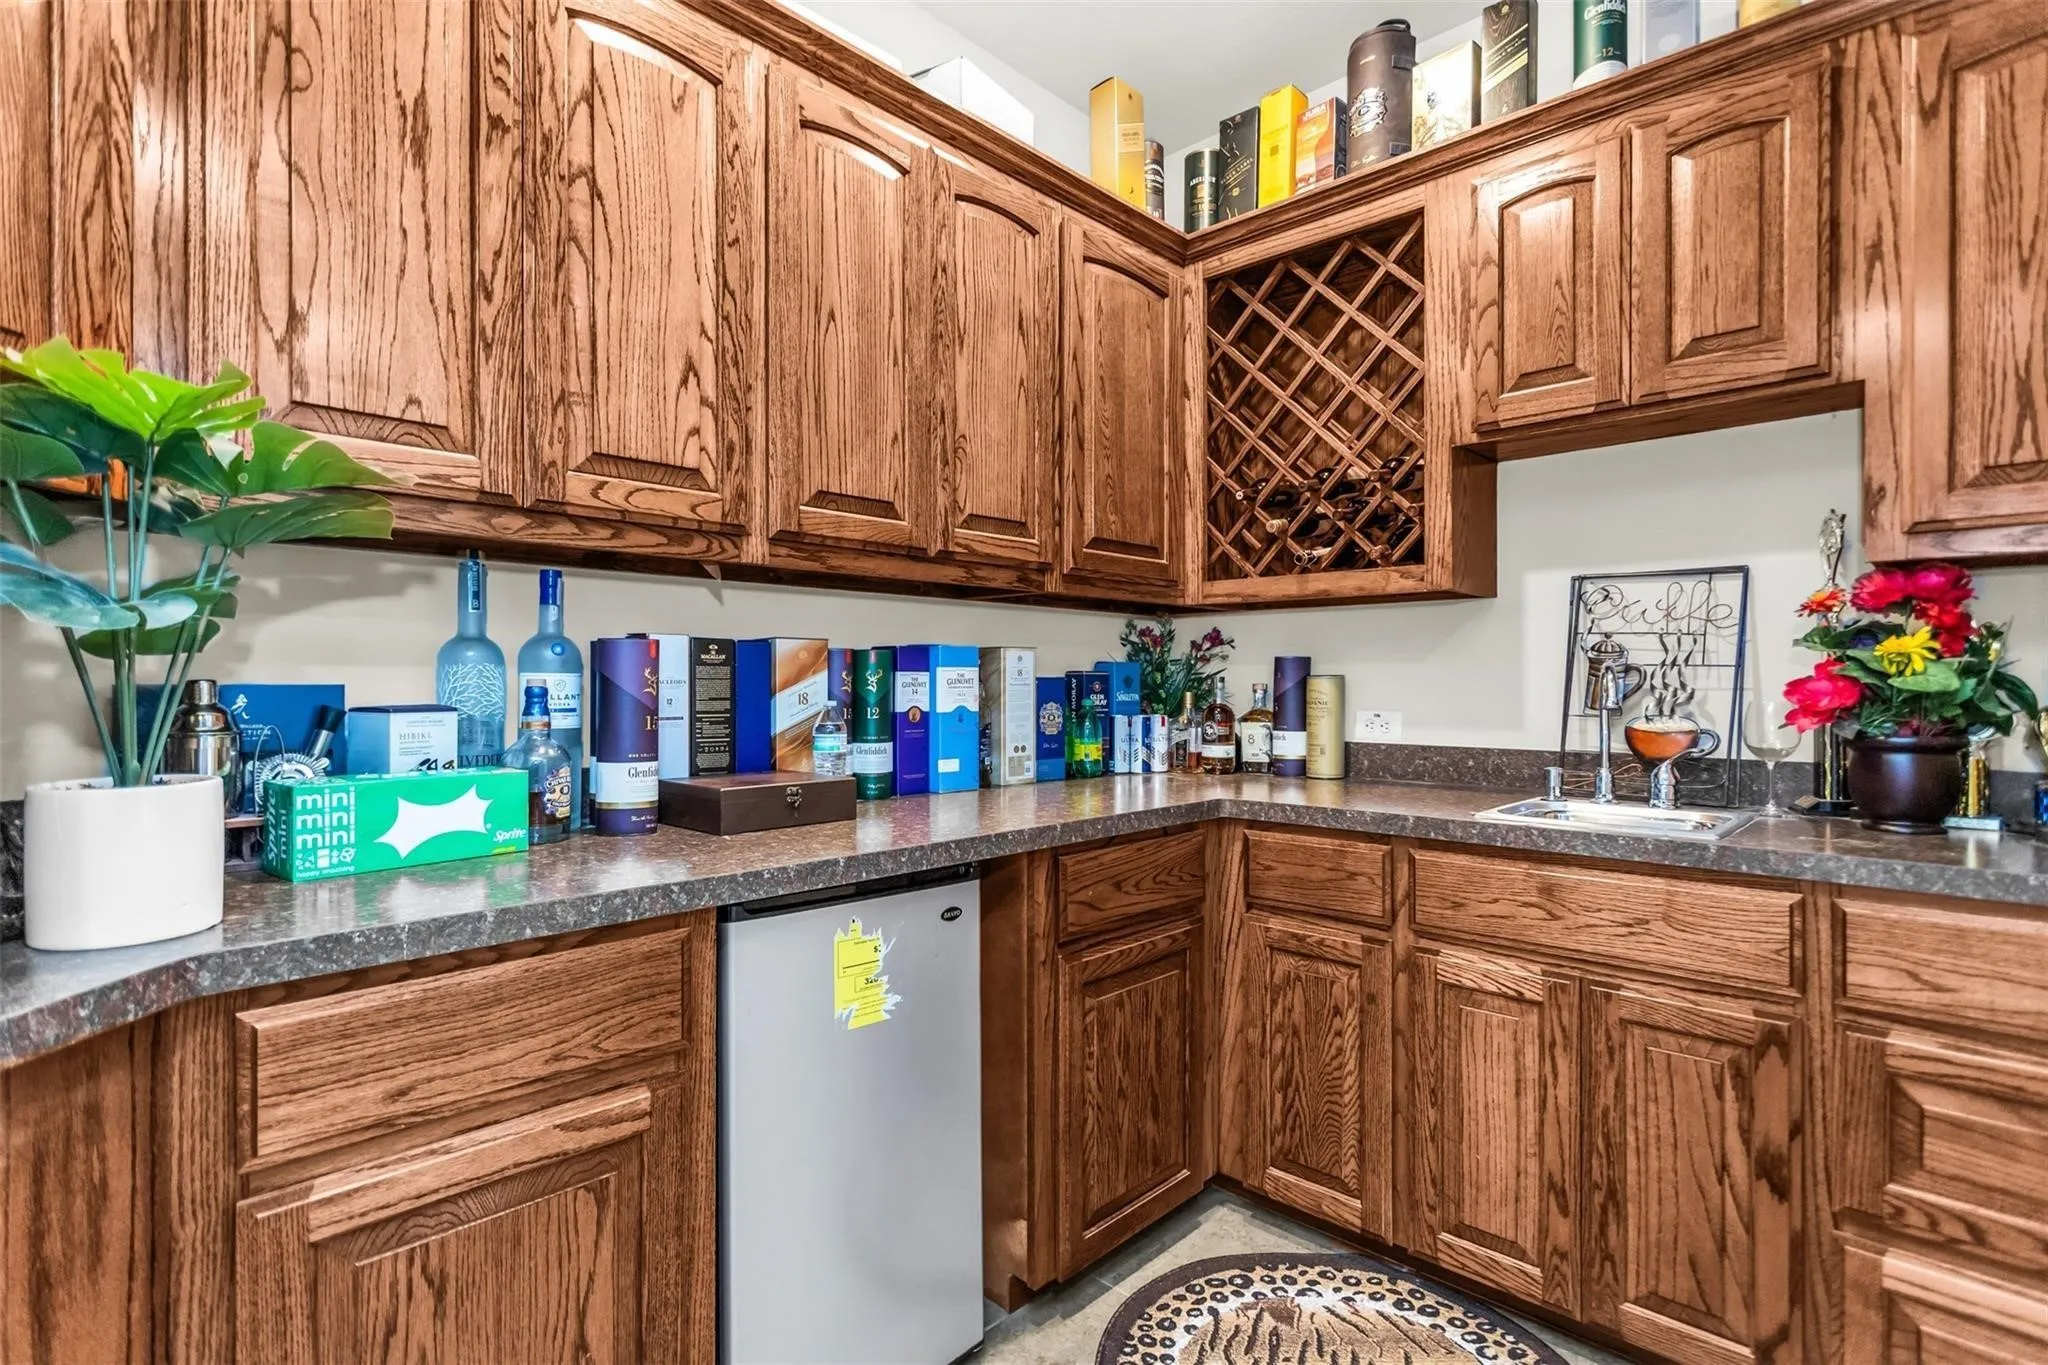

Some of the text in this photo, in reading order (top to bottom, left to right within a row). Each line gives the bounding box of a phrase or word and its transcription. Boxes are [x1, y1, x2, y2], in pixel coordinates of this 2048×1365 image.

[1602, 47, 1614, 56] 12
[946, 678, 974, 686] GLENLIVET
[798, 692, 809, 705] 18
[866, 707, 880, 719] 12
[1247, 734, 1255, 744] 8
[856, 745, 888, 756] Glenfiddich
[296, 786, 356, 811] mini
[296, 804, 356, 830] mini
[266, 789, 278, 867] Sprite
[278, 809, 287, 859] mini
[296, 824, 356, 850] mini
[493, 828, 527, 843] Sprite
[943, 909, 961, 918] SANYO
